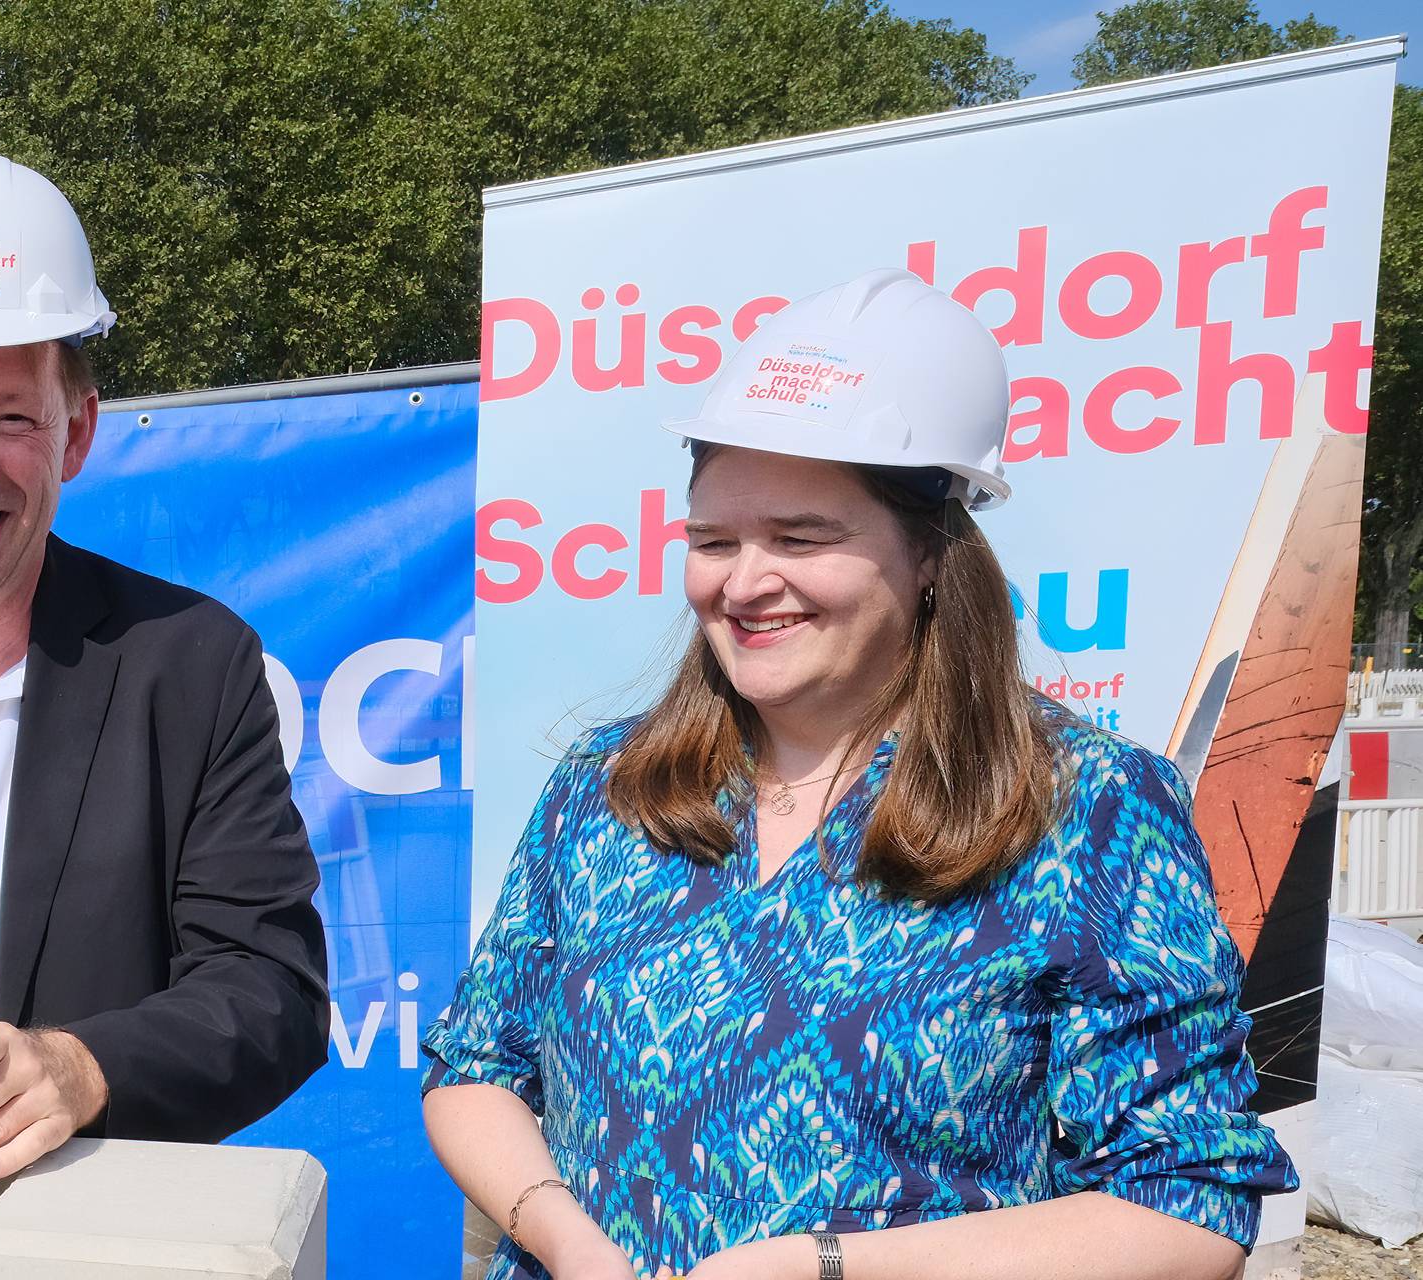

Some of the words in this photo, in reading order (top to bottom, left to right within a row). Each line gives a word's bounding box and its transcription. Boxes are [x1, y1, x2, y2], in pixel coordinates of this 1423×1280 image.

[758, 357, 865, 387] Düsseldorf
[745, 384, 808, 404] Schule
[1001, 320, 1375, 464] acht
